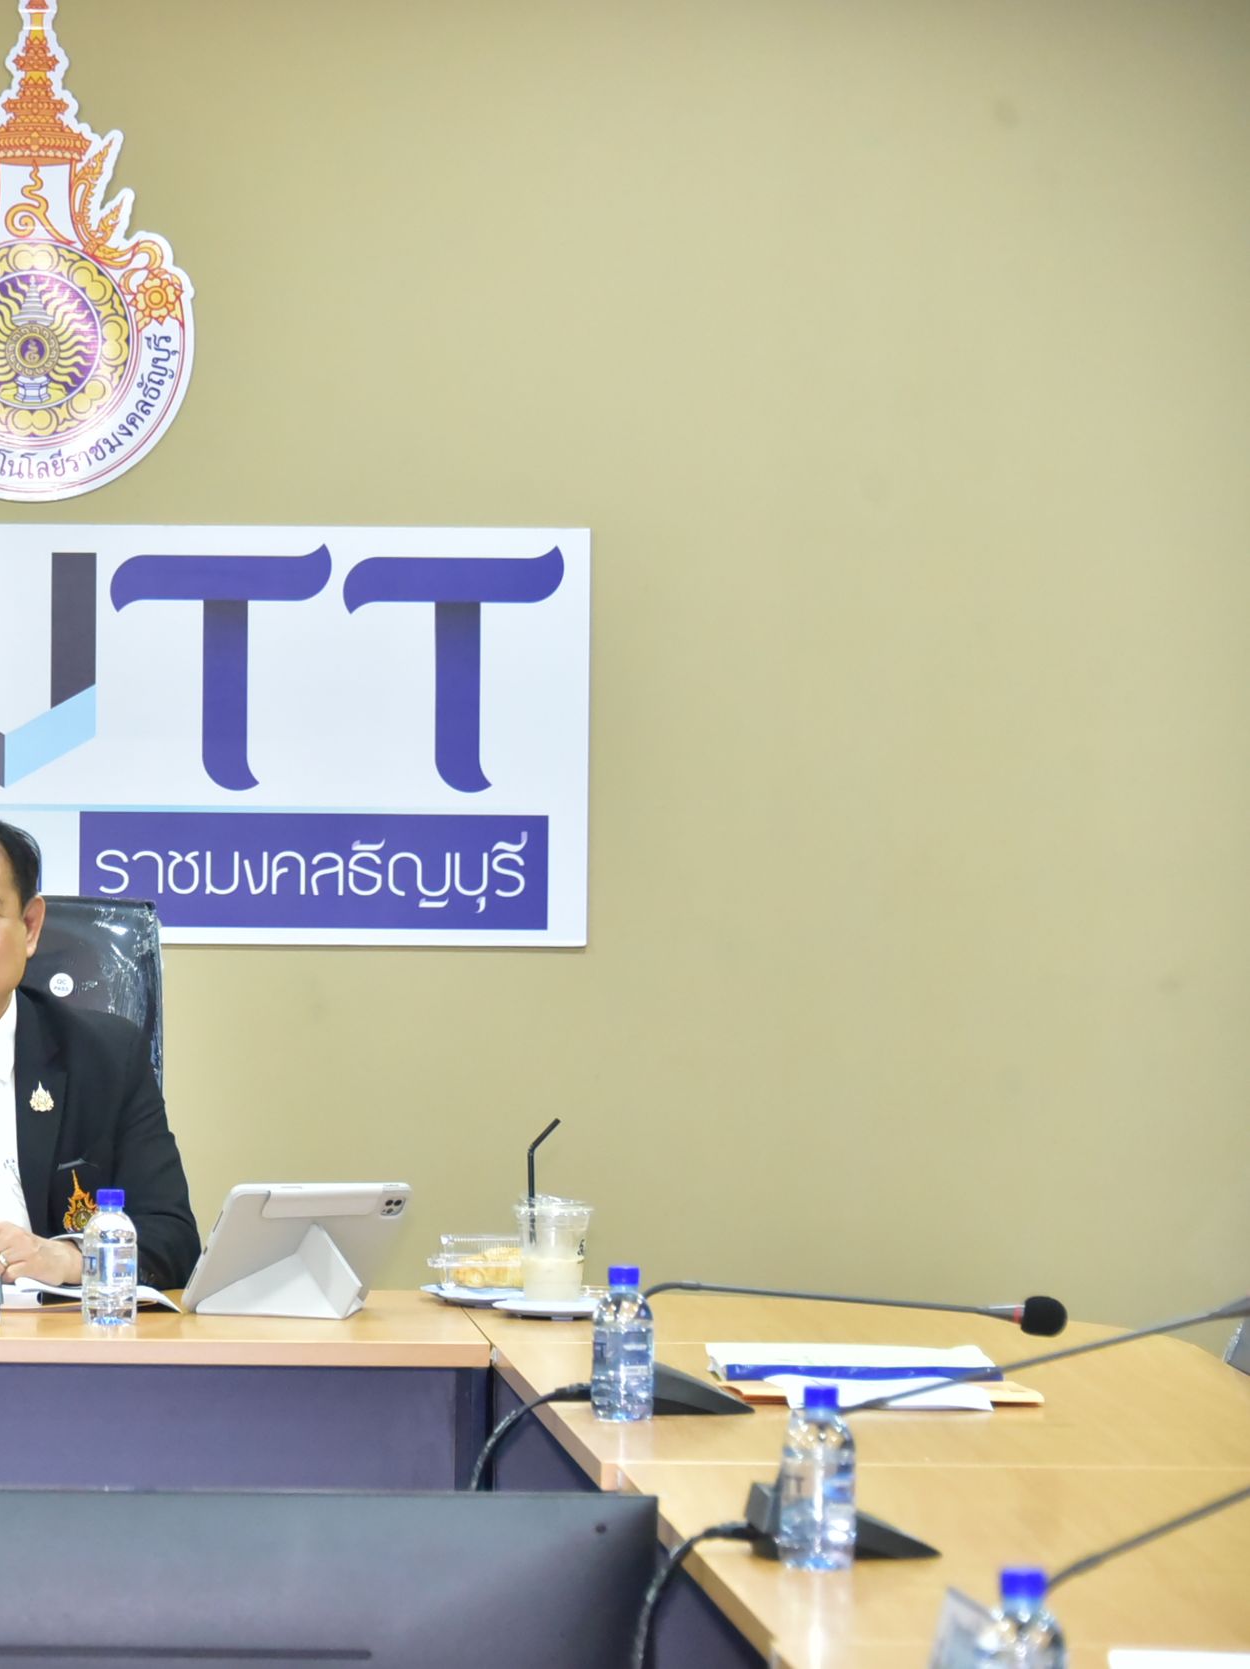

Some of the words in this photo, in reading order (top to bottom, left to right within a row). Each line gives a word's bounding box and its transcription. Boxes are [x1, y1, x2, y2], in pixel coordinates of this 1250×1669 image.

[95, 831, 529, 914] ราชมงคลธัญบุรี
